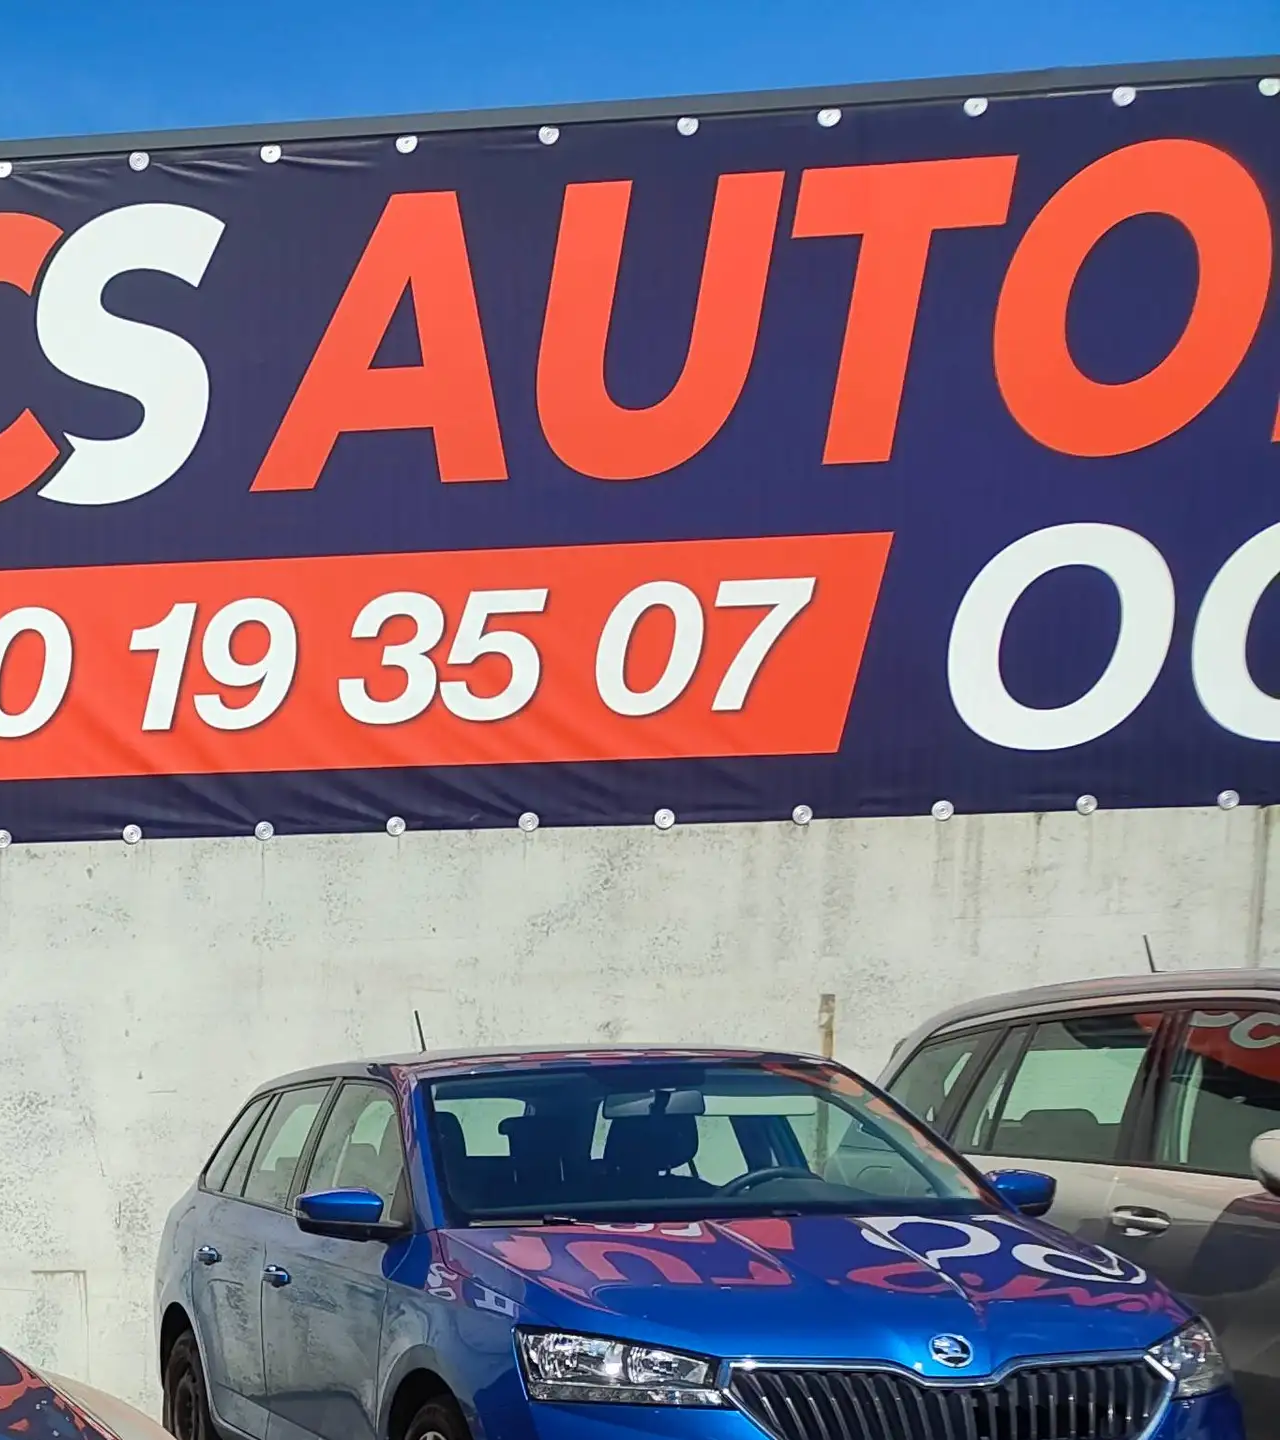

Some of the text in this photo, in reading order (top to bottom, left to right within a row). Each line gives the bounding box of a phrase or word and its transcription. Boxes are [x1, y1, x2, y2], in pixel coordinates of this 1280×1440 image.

[249, 138, 1280, 492] AUTO
[128, 597, 298, 731] 19
[338, 587, 549, 727] 35
[594, 576, 817, 718] 07
